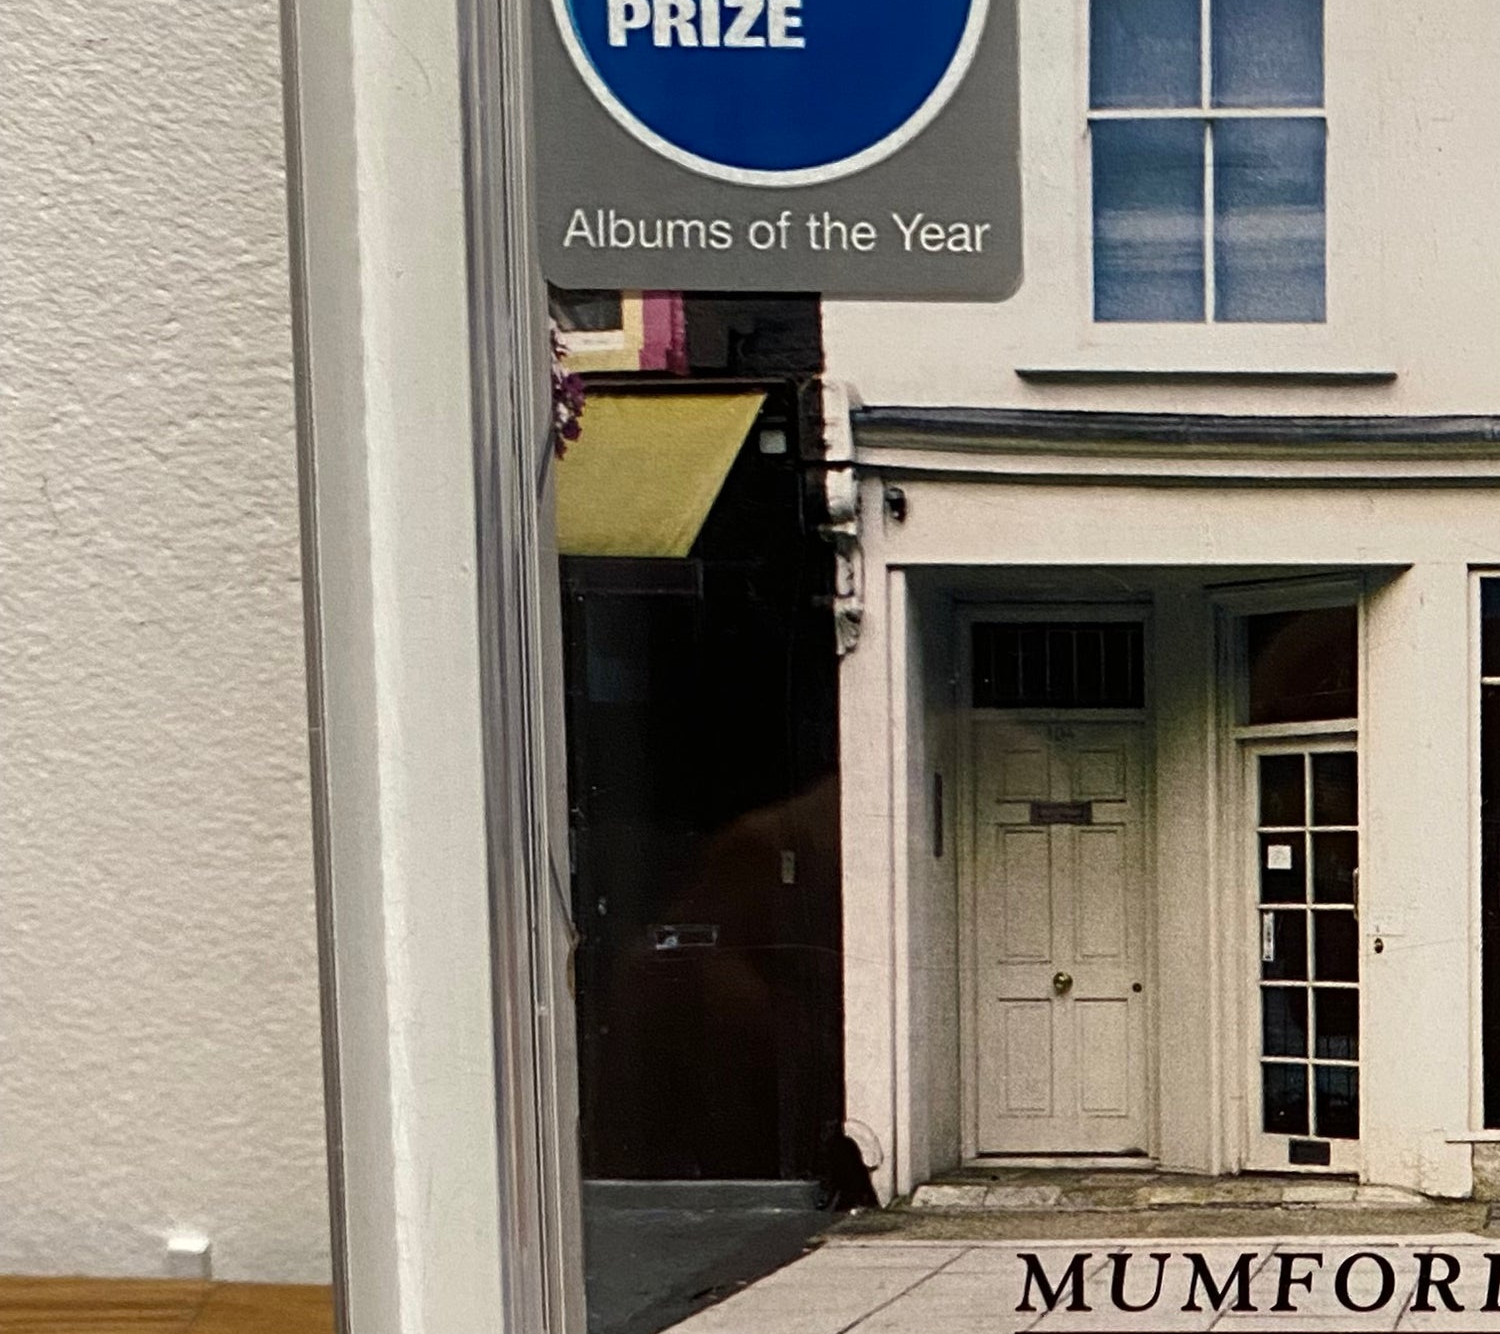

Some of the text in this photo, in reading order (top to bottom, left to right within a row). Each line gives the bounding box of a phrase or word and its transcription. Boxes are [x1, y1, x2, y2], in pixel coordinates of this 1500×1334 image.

[563, 209, 991, 253] Albums of the Year
